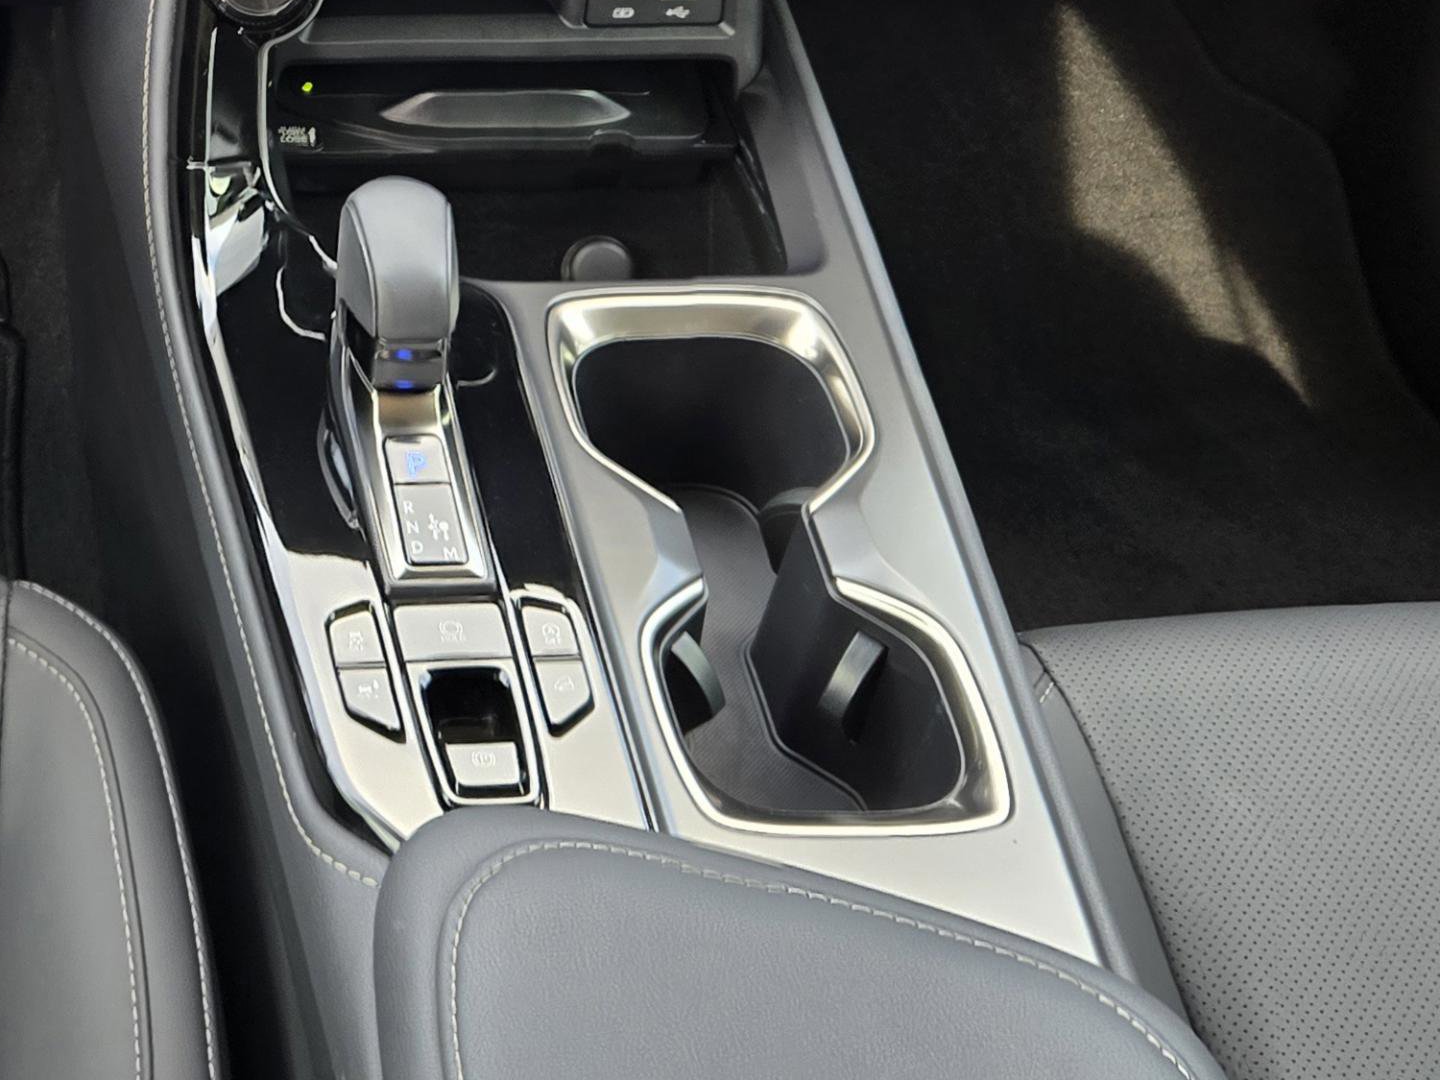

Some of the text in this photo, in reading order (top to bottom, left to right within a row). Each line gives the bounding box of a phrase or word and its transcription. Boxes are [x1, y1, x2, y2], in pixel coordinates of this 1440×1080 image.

[406, 450, 428, 478] P
[403, 501, 415, 515] R
[406, 520, 419, 534] N
[411, 540, 423, 554] D
[443, 546, 459, 561] M
